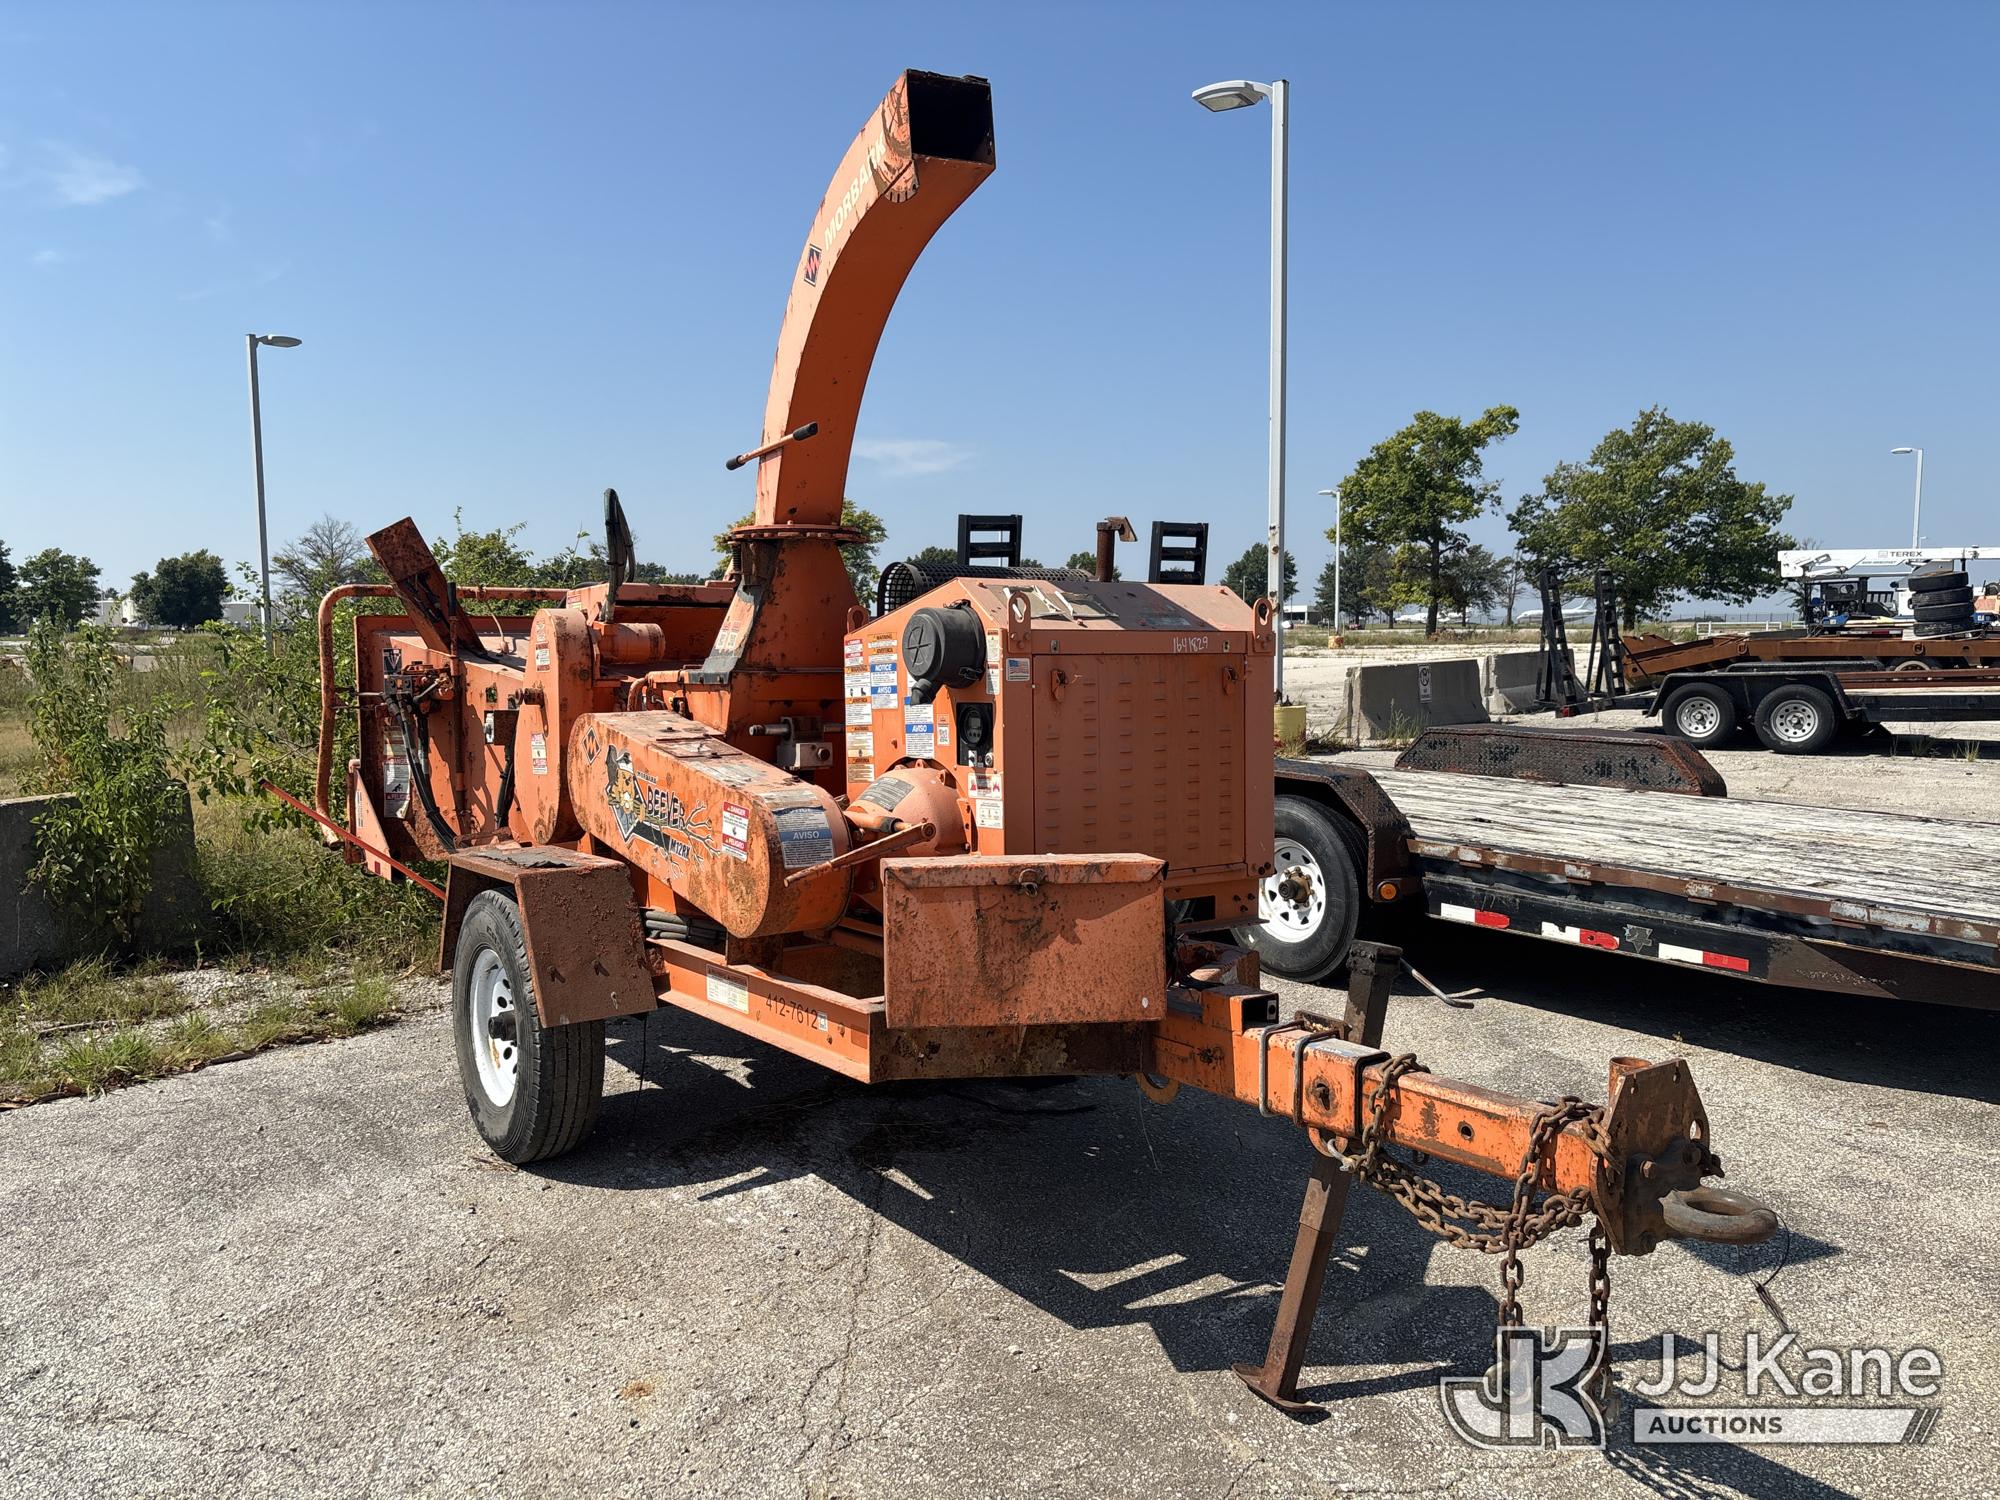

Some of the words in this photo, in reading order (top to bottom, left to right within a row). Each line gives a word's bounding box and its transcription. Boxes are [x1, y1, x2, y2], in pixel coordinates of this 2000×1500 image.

[875, 663, 893, 671] NOTICE
[877, 686, 892, 694] AVISO
[911, 724, 928, 733] AVISO
[647, 785, 686, 829] BEEVER
[730, 805, 747, 816] DANGER
[793, 830, 820, 841] AVISO
[670, 838, 691, 860] M12RX
[729, 838, 746, 850] PELIGRO
[765, 993, 819, 1030] 412-7612
